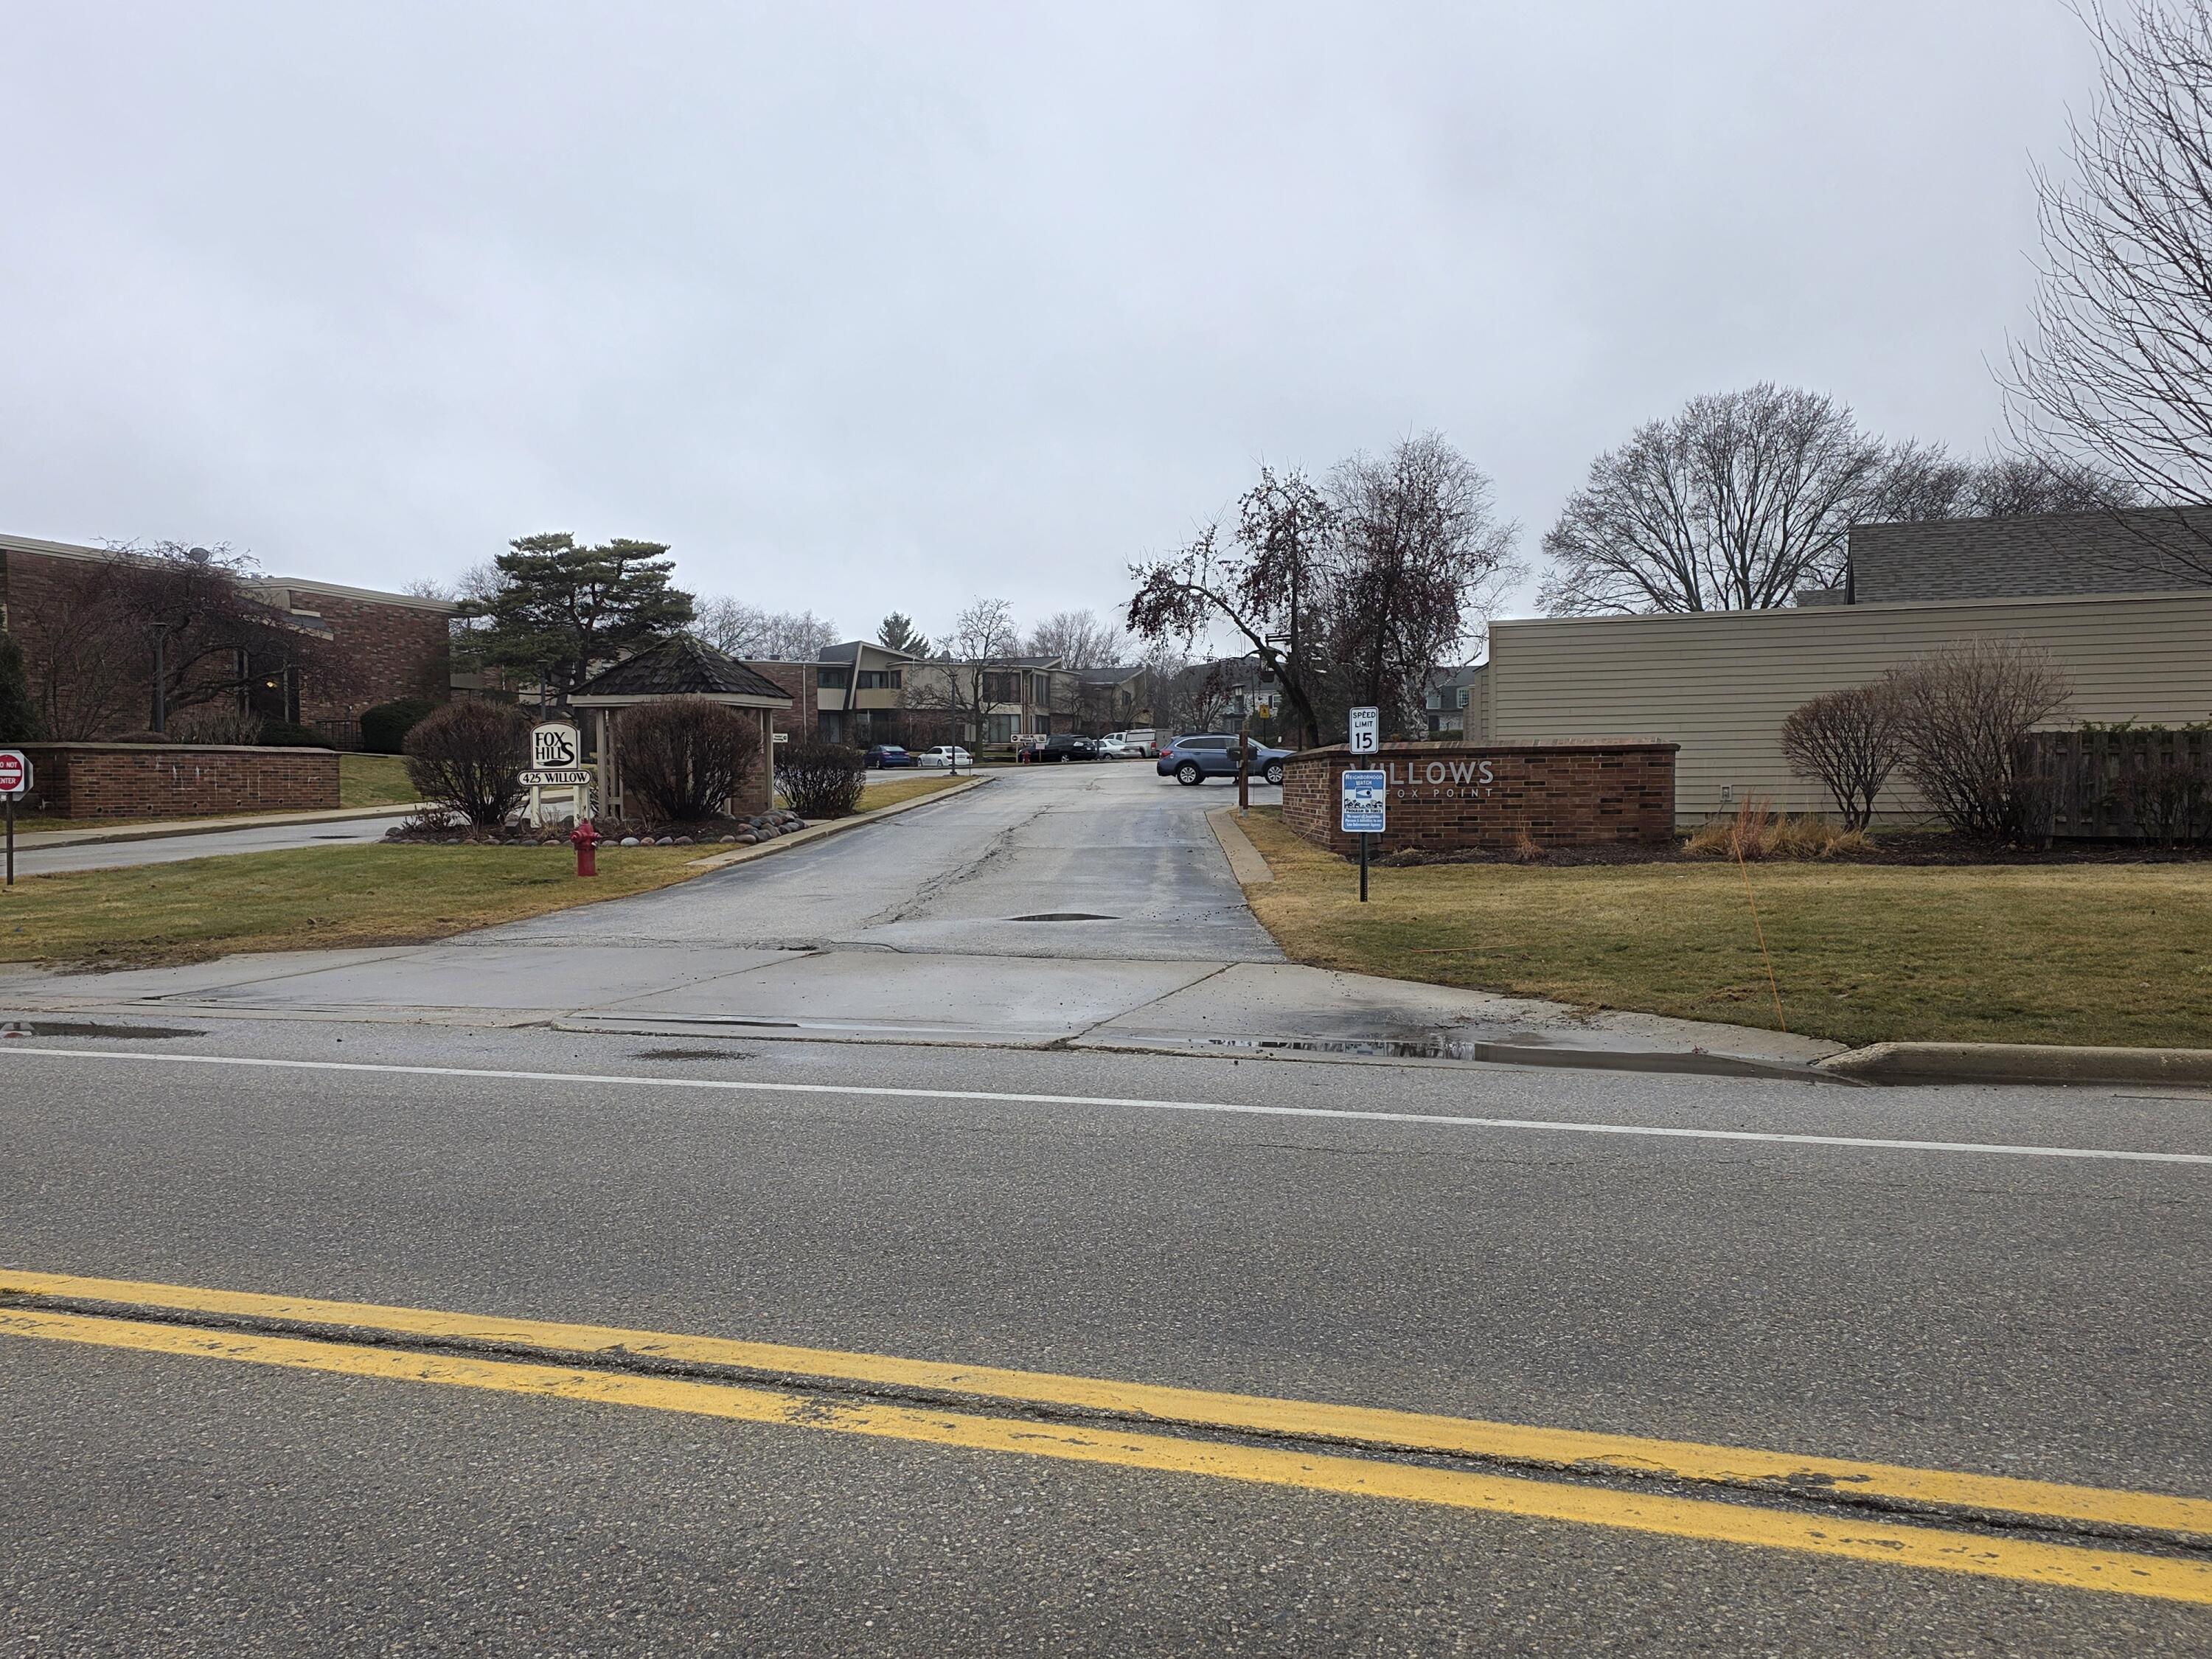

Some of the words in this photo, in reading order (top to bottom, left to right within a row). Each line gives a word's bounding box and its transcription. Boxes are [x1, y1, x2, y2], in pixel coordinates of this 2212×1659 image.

[535, 731, 566, 747] FOX
[1355, 732, 1373, 749] 15
[535, 742, 574, 765] HILLS
[523, 773, 541, 783] 425
[544, 772, 588, 783] WILLOW
[1433, 788, 1493, 798] POINT
